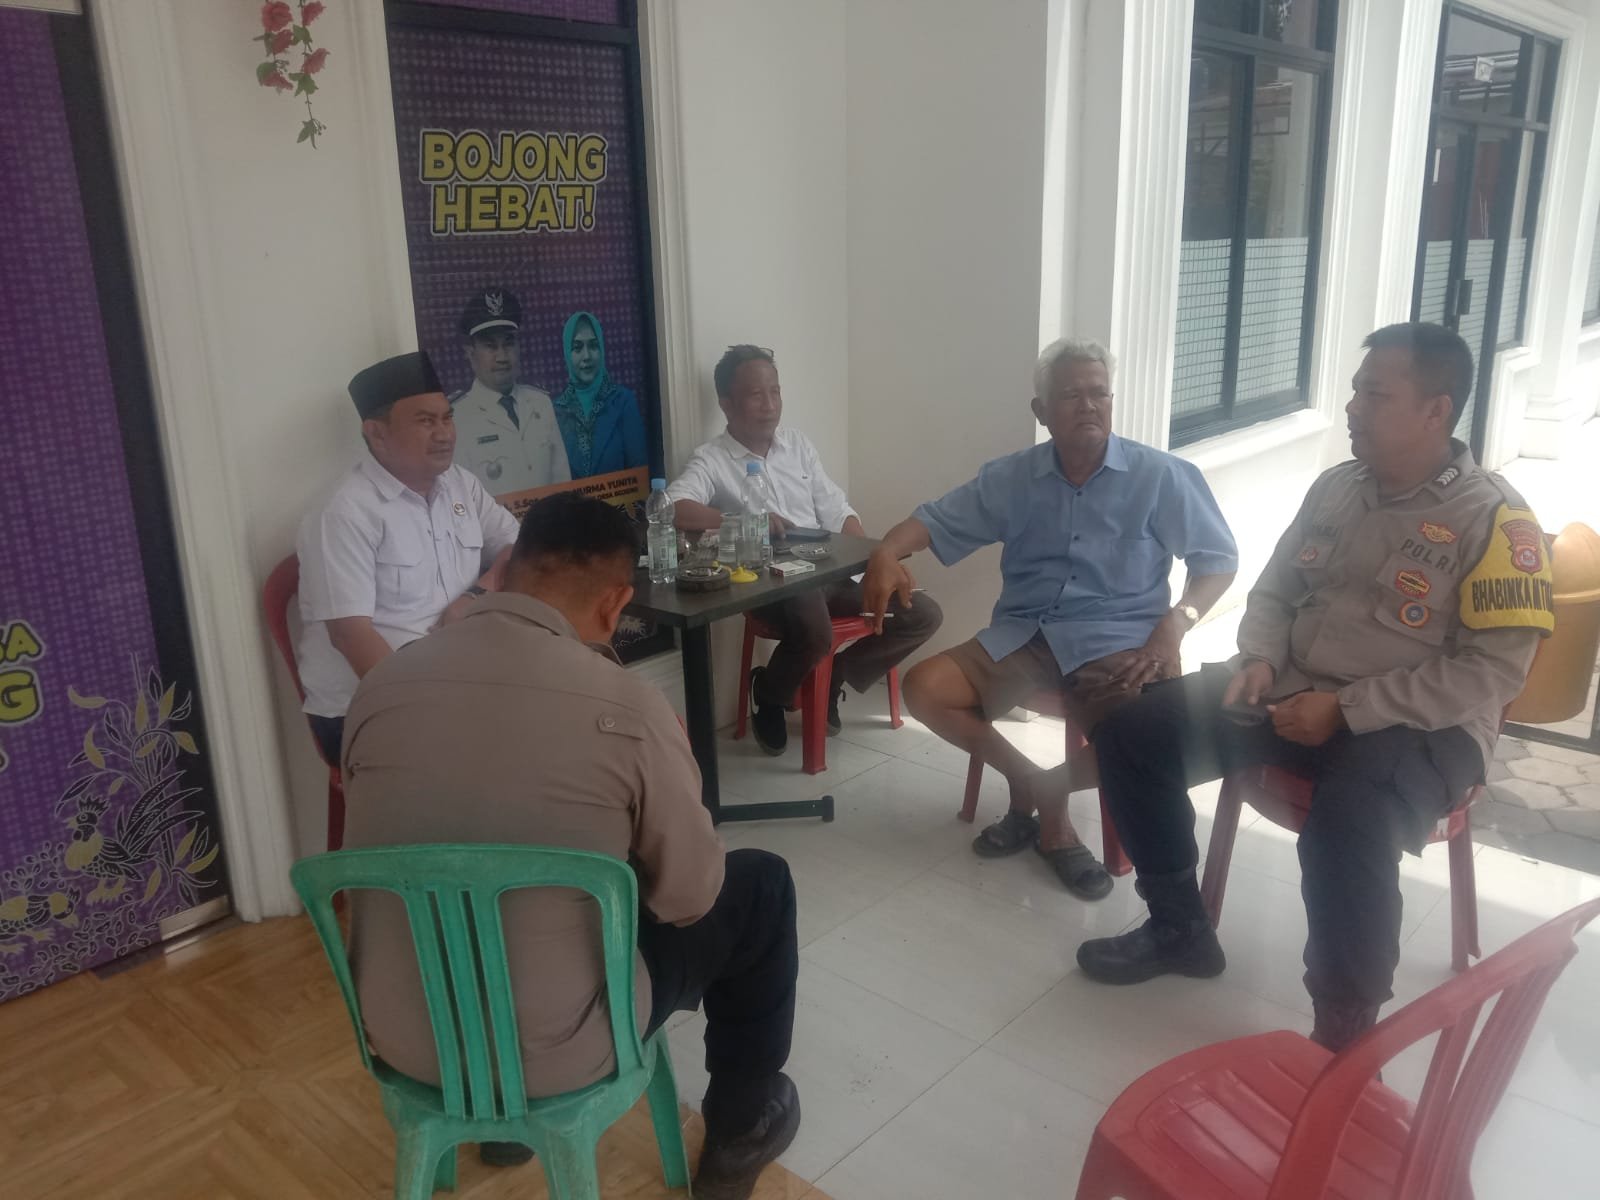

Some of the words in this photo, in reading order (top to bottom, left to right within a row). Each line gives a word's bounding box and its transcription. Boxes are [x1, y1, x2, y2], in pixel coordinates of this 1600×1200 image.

[420, 129, 607, 182] BOJONG
[431, 183, 596, 235] HEBAT!
[607, 476, 639, 489] YUNITA
[1400, 538, 1457, 575] POLRI
